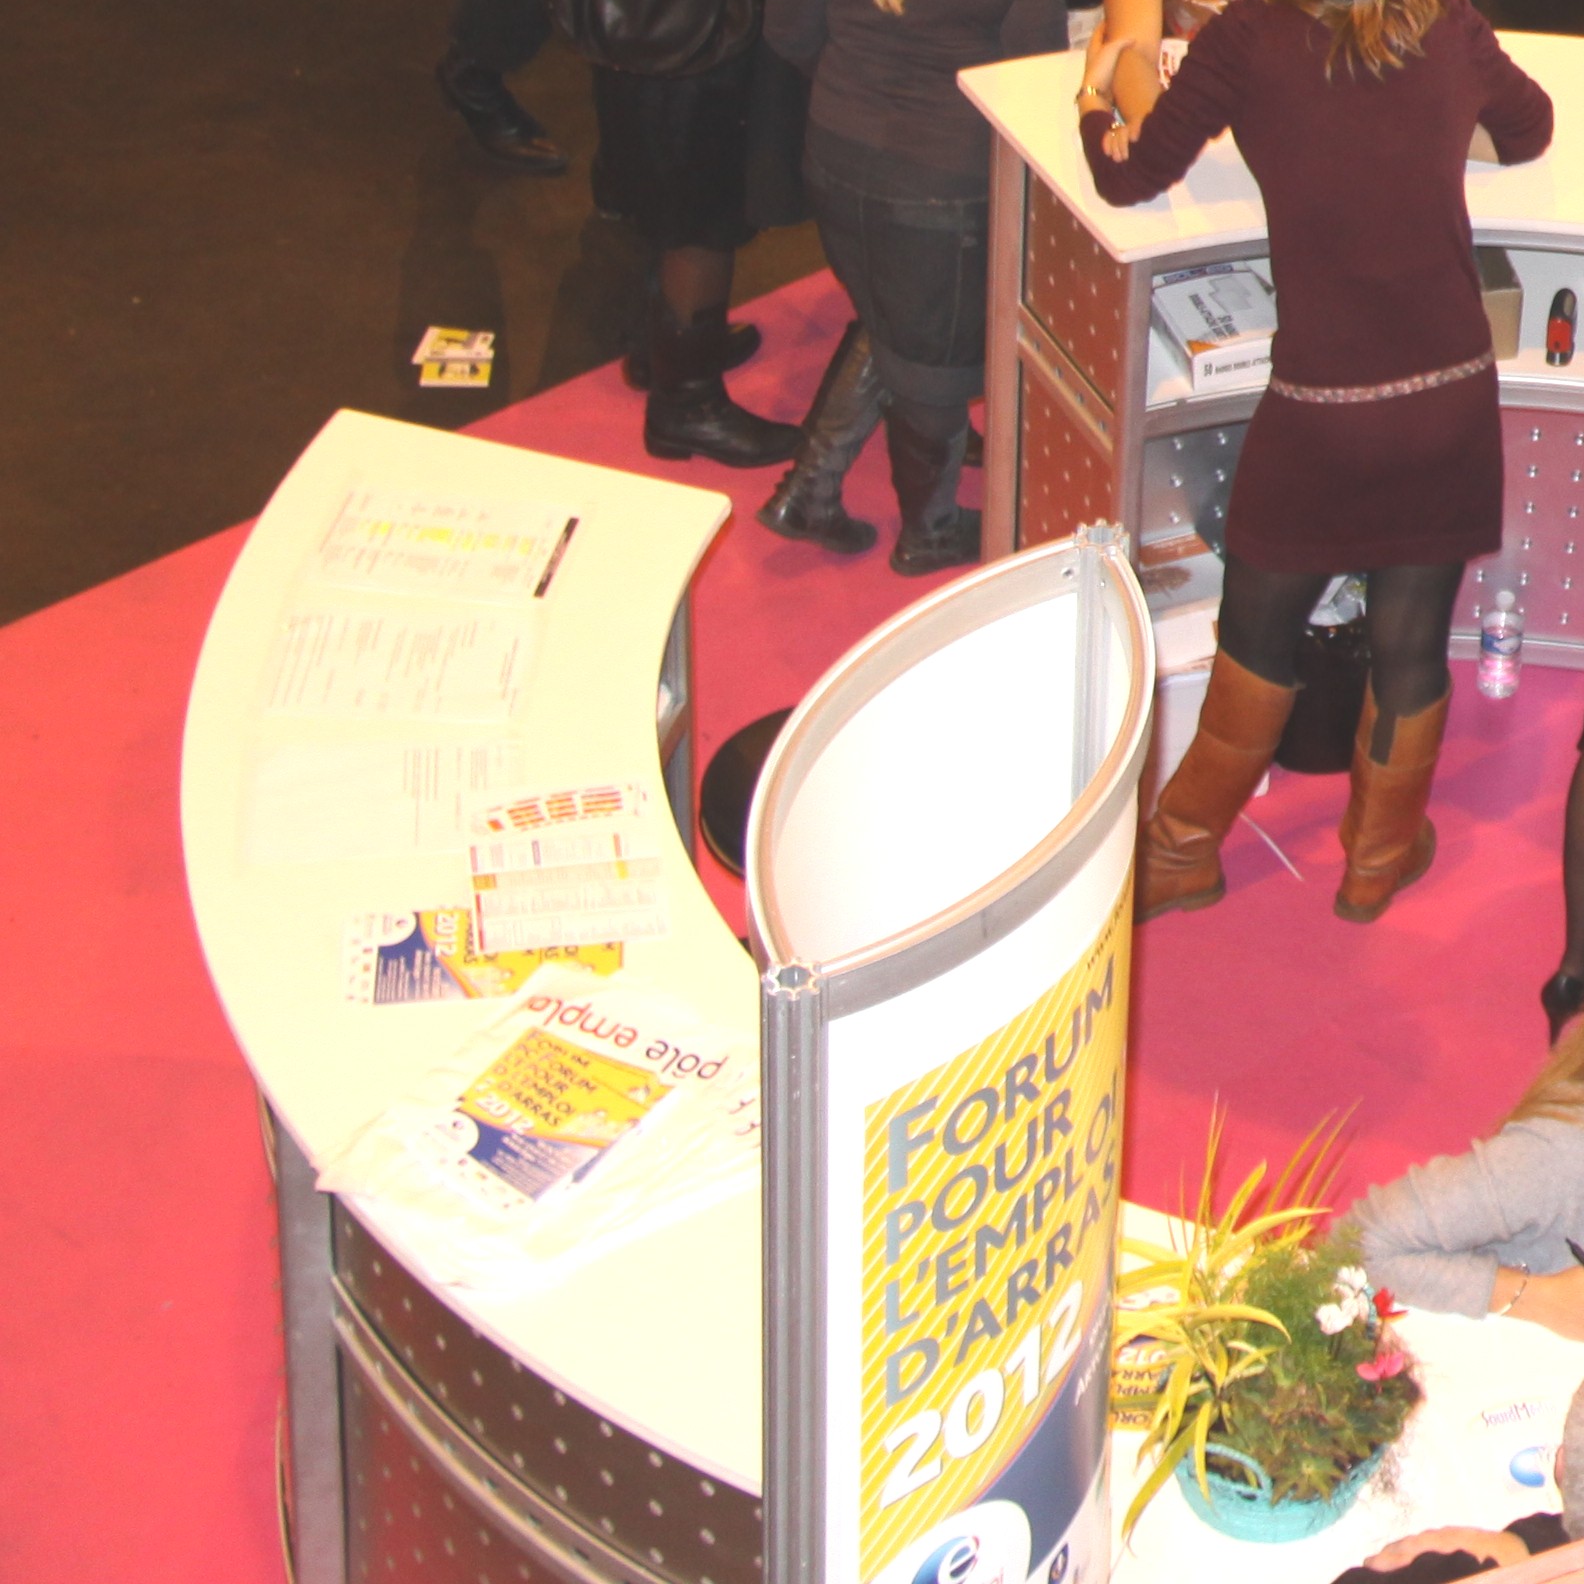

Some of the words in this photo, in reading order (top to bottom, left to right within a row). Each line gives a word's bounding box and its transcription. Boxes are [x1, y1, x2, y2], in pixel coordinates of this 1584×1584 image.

[527, 995, 640, 1050] emplo
[645, 1039, 730, 1081] pôle
[888, 953, 1115, 1195] FORUM
[886, 1087, 1074, 1266] POUR
[879, 1280, 1084, 1511] 2012
